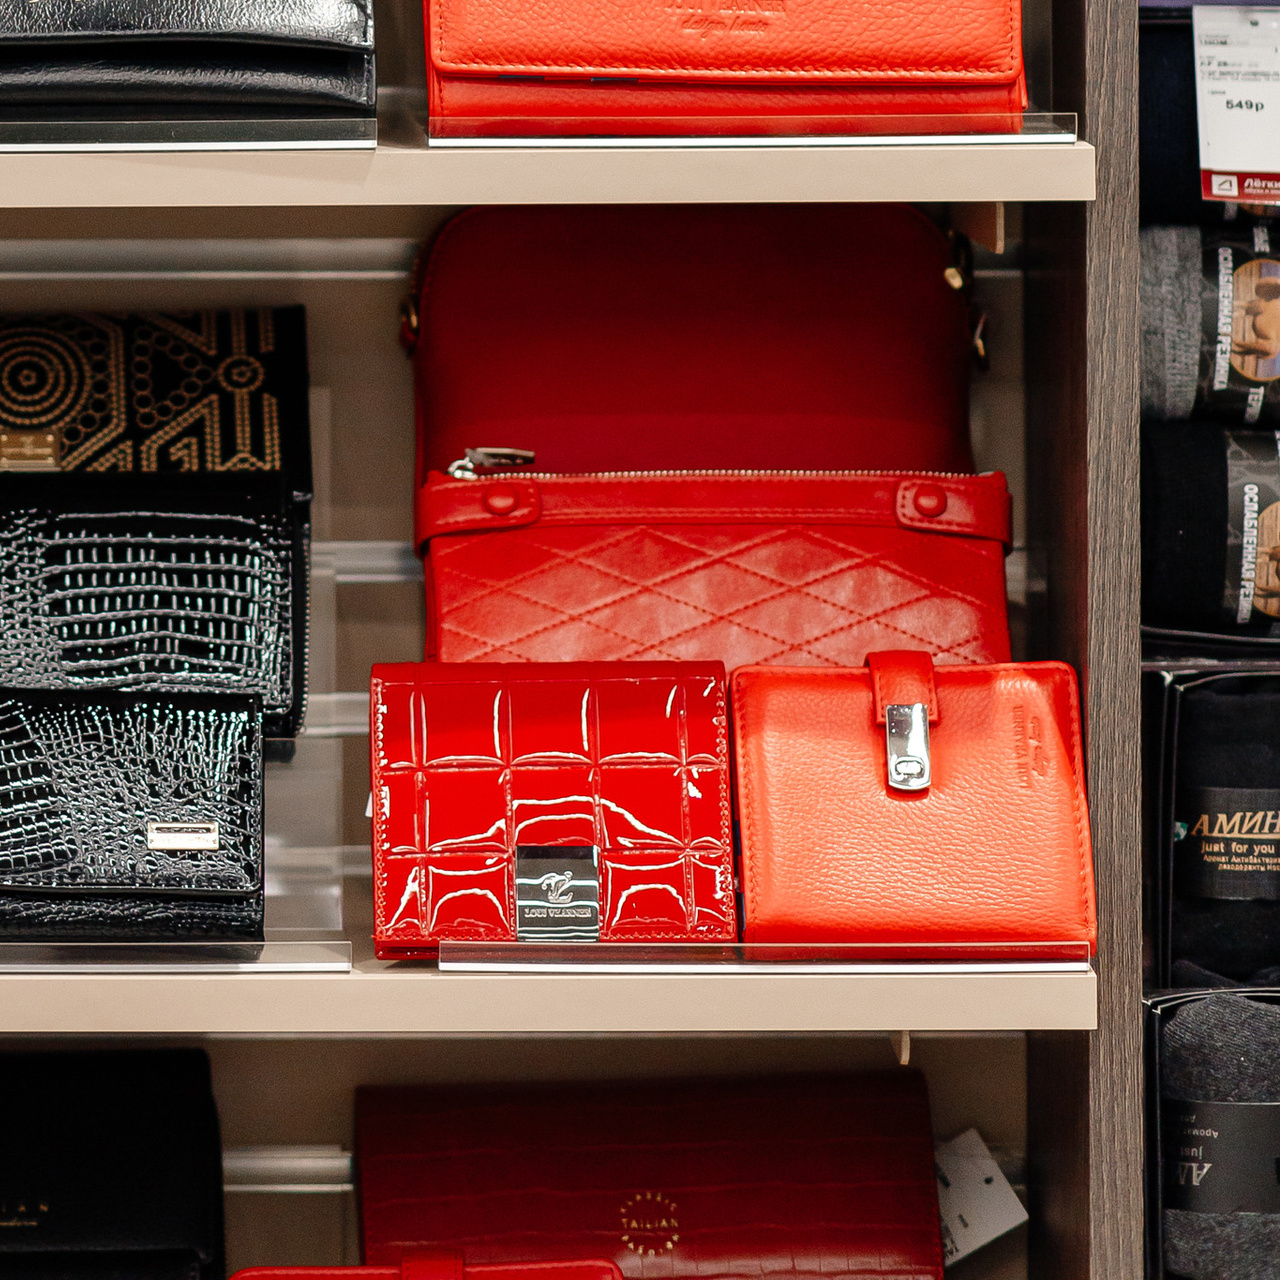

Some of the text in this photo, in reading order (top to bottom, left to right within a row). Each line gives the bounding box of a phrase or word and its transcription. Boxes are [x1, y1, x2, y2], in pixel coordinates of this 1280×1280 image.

[1226, 99, 1264, 112] 549р
[1241, 483, 1259, 579] ОСЛАБЛЕННАЯ
[1231, 841, 1249, 853] for
[1253, 844, 1275, 856] you
